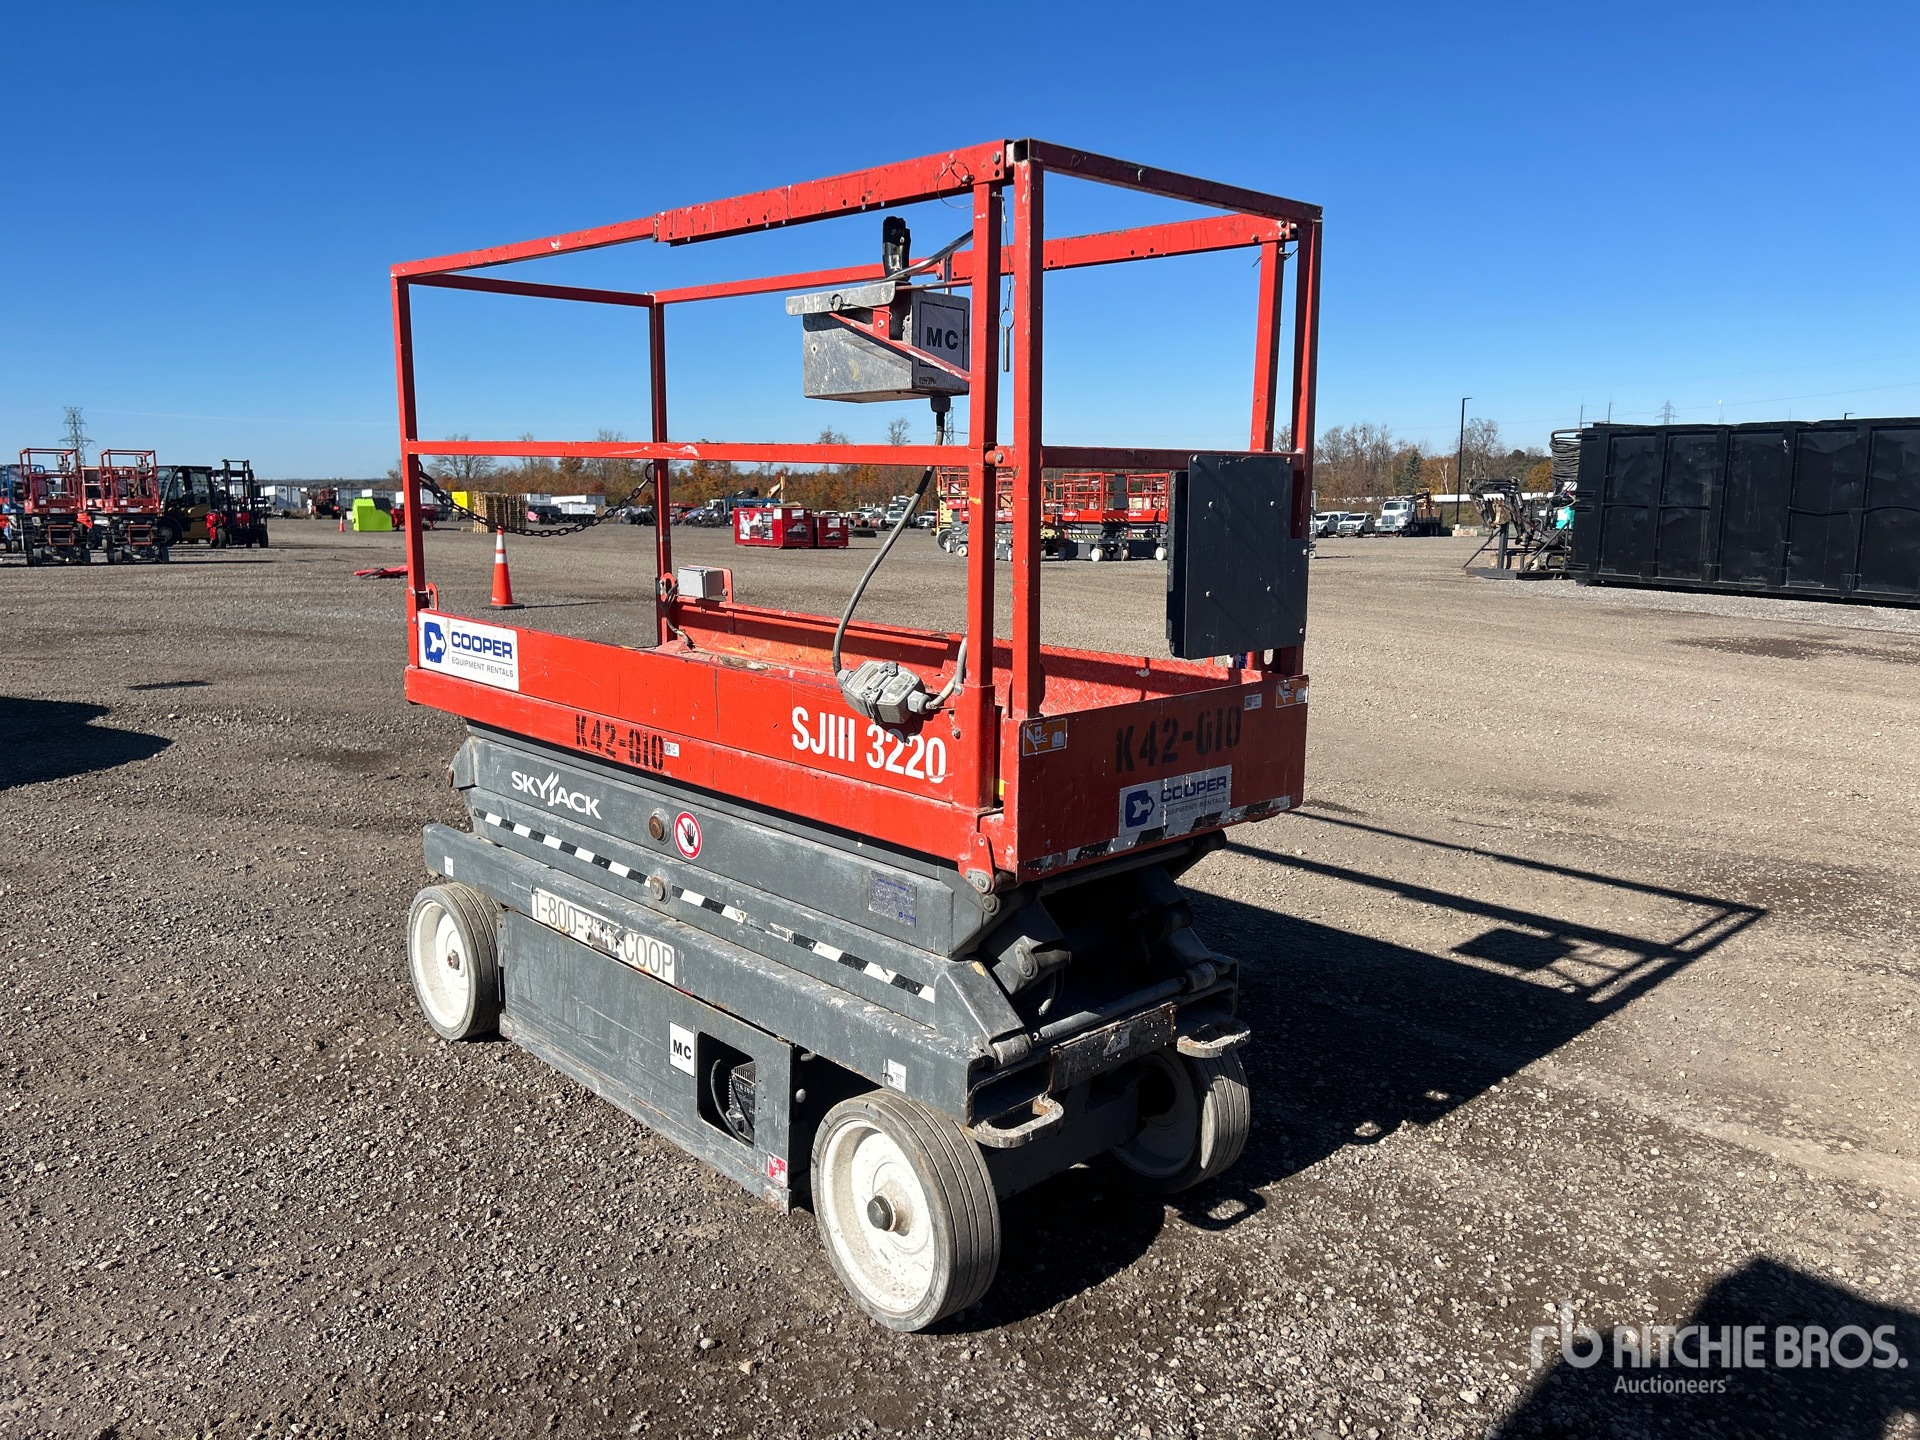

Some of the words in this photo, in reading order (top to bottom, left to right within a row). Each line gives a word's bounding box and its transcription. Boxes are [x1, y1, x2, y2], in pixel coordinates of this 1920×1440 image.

[926, 326, 959, 351] MC
[451, 630, 513, 660] COOPER
[451, 657, 485, 672] EQUIPMENT
[486, 664, 514, 678] RENTALS
[790, 706, 857, 763] SJIII
[865, 722, 948, 785] 3220
[510, 769, 603, 821] SKYJACK
[1160, 775, 1227, 803] COOPER
[1159, 803, 1198, 818] EQUIPMENT
[1199, 796, 1226, 809] RENTALS
[672, 1038, 692, 1061] MC
